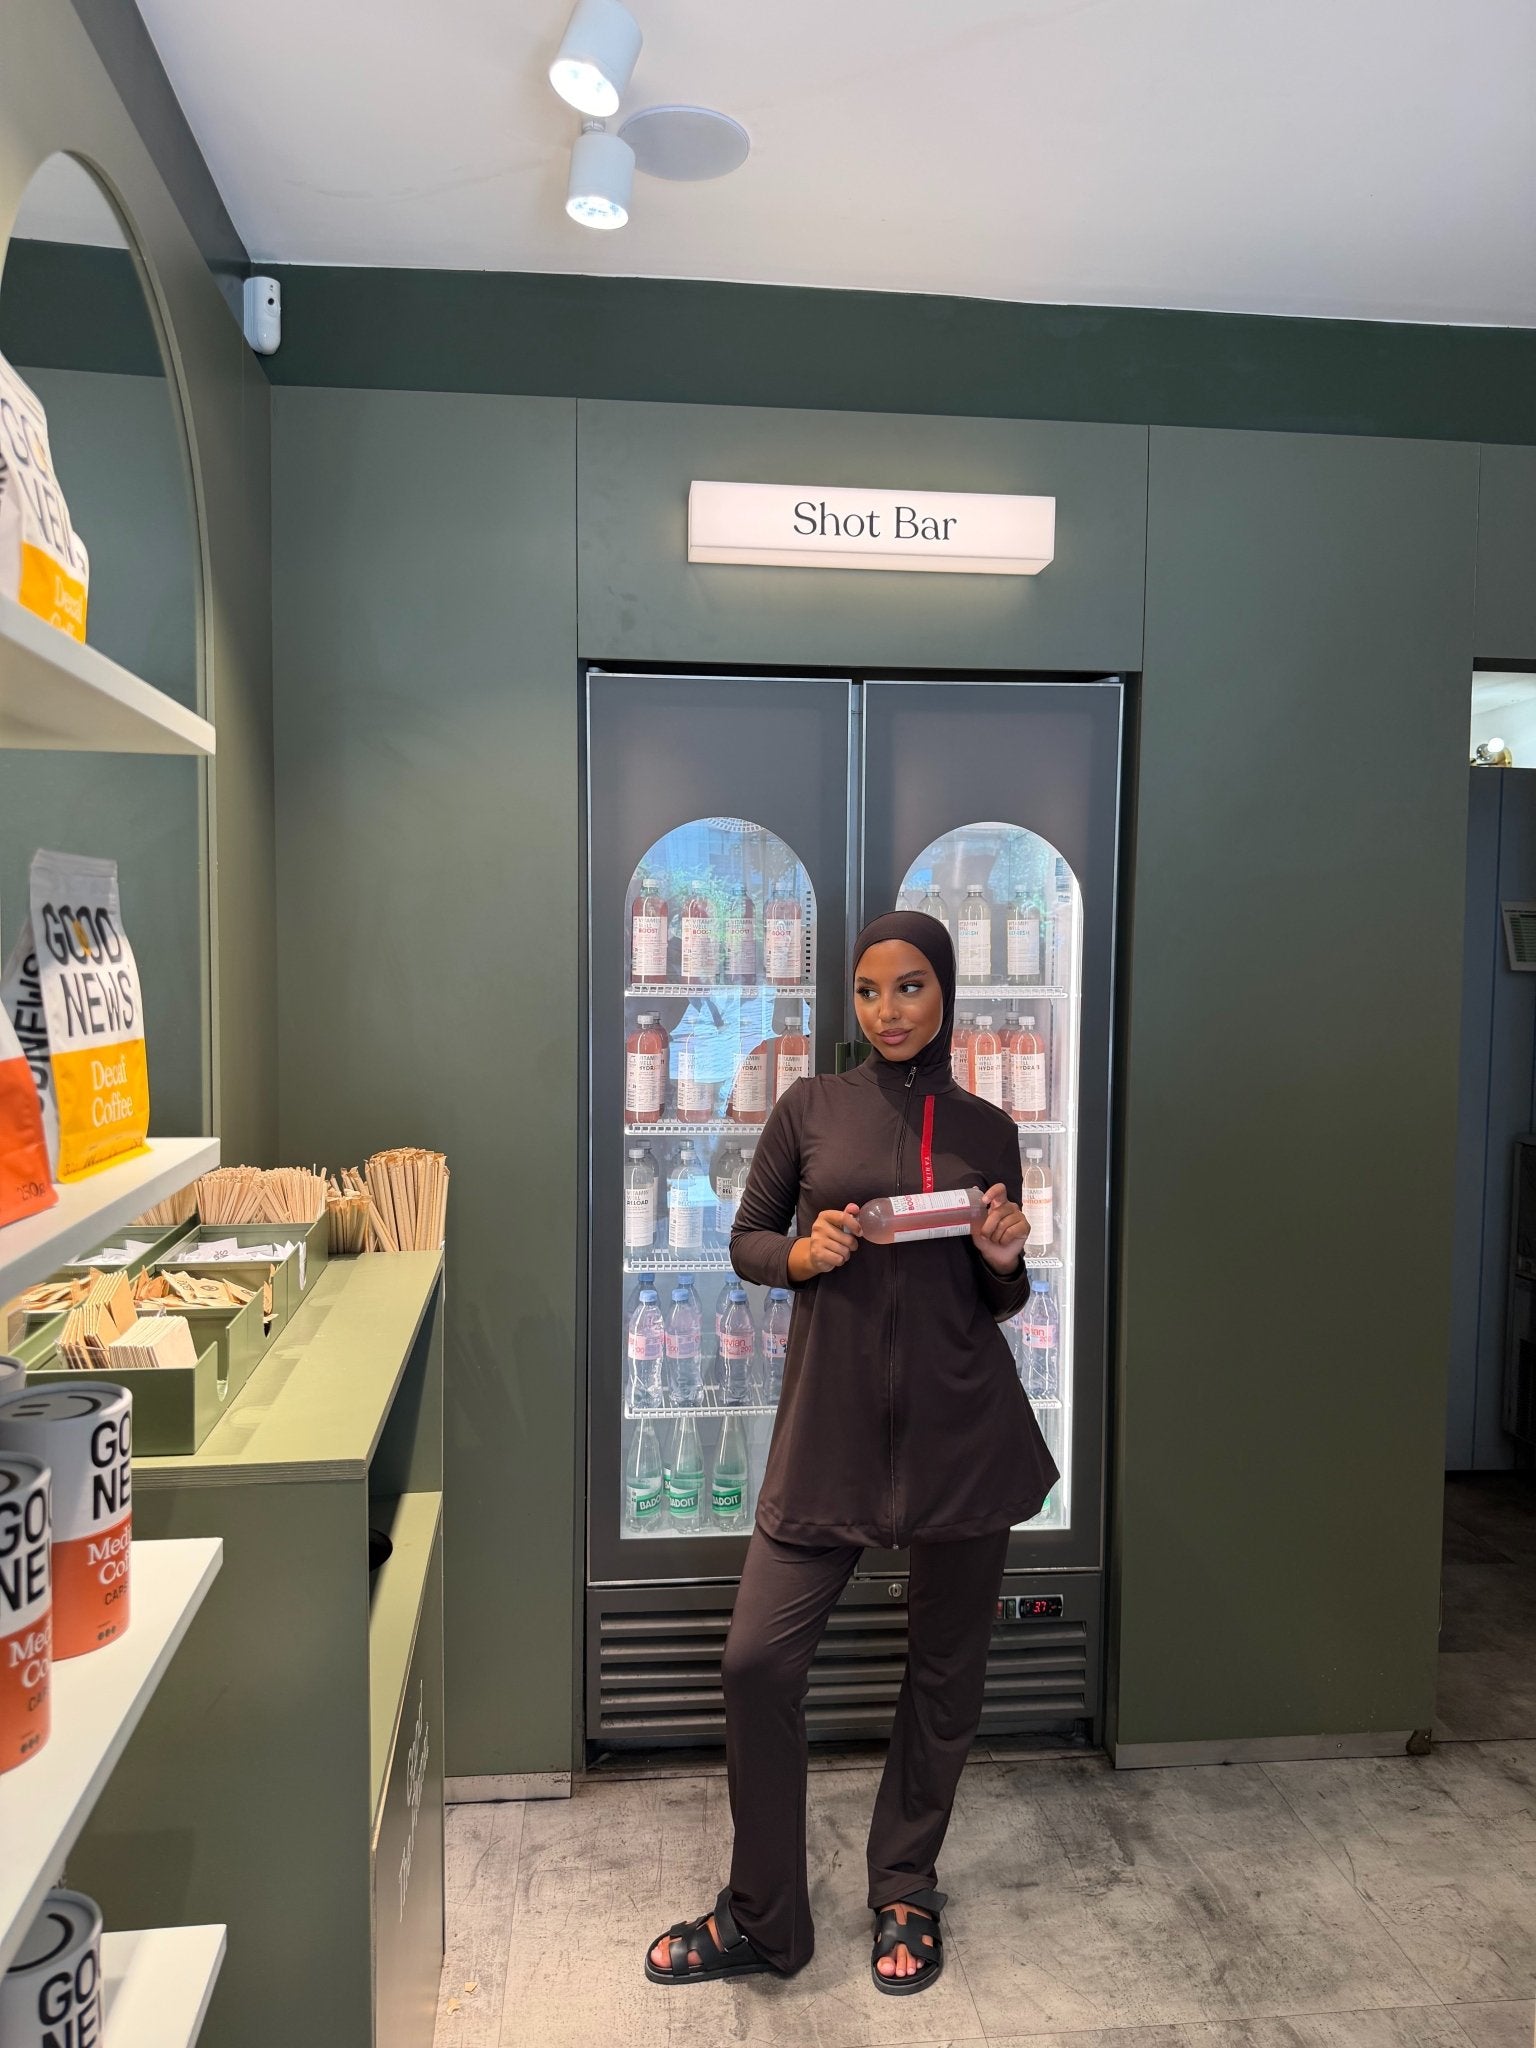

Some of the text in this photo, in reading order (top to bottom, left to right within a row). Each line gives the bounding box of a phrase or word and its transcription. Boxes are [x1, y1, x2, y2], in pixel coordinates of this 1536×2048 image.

[793, 501, 957, 541] Shot Bar
[42, 902, 122, 966] GOOD
[60, 970, 134, 1038] NEWS
[91, 1054, 128, 1091] Decaf
[92, 1091, 134, 1128] Coffee
[924, 1155, 932, 1189] TAHIRA
[91, 1410, 131, 1468] GO
[93, 1459, 131, 1520] NE
[639, 1494, 661, 1510] BADO
[0, 1488, 52, 1558] GO
[0, 1538, 52, 1612] NE
[38, 1949, 102, 2027] GO
